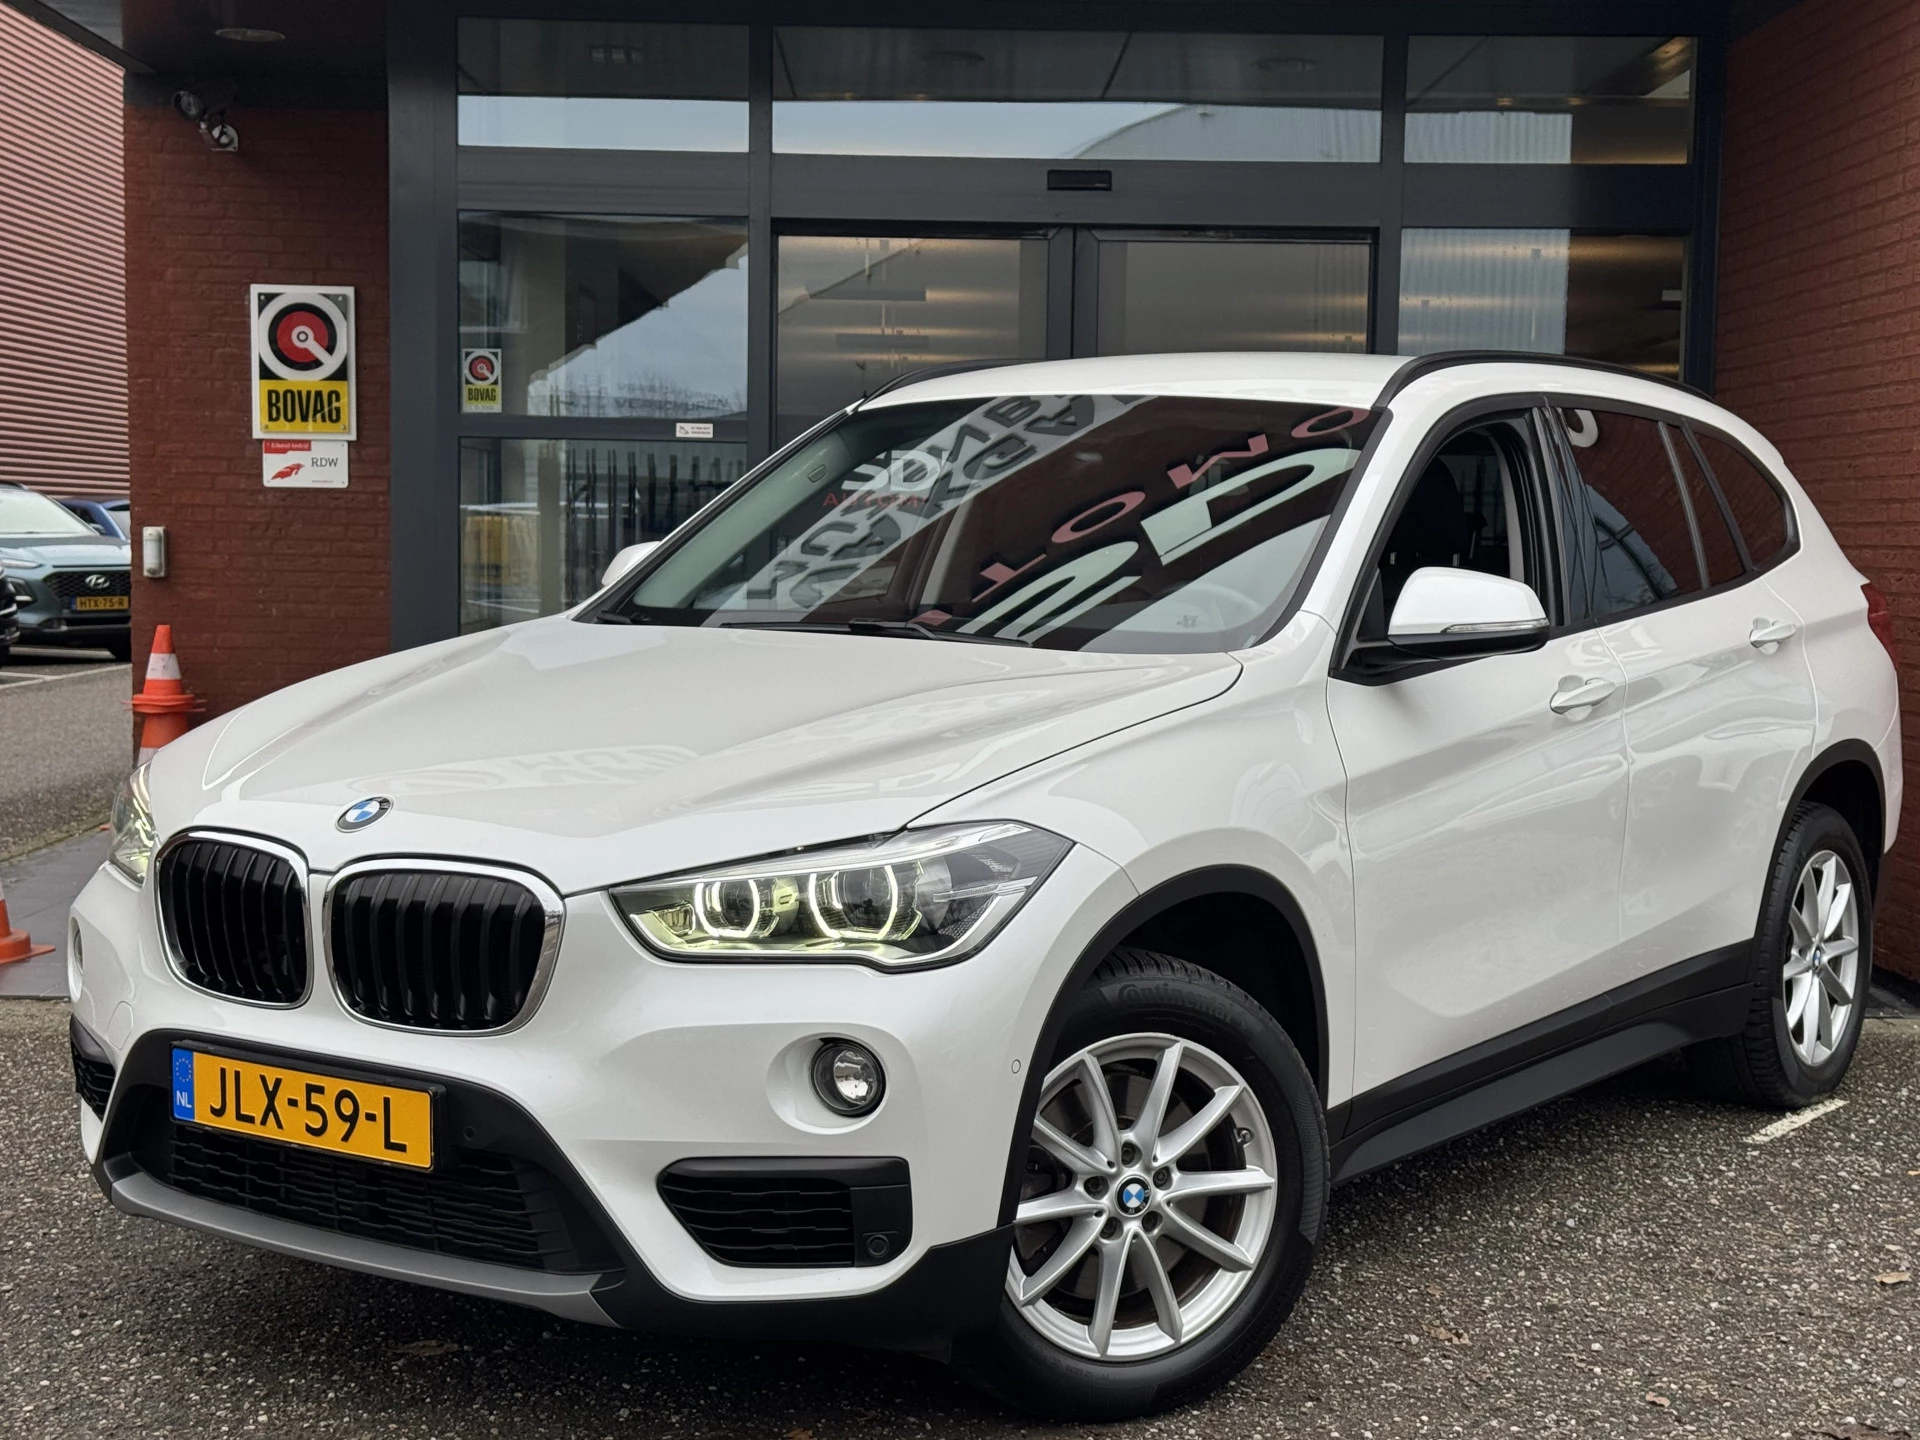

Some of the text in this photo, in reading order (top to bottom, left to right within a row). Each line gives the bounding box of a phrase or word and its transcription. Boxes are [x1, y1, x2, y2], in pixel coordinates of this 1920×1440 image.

[468, 388, 496, 402] BOVAG
[267, 388, 341, 423] BOVAG
[311, 457, 338, 467] RDW
[176, 1089, 192, 1109] NL
[210, 1067, 407, 1152] JLX-59-L
